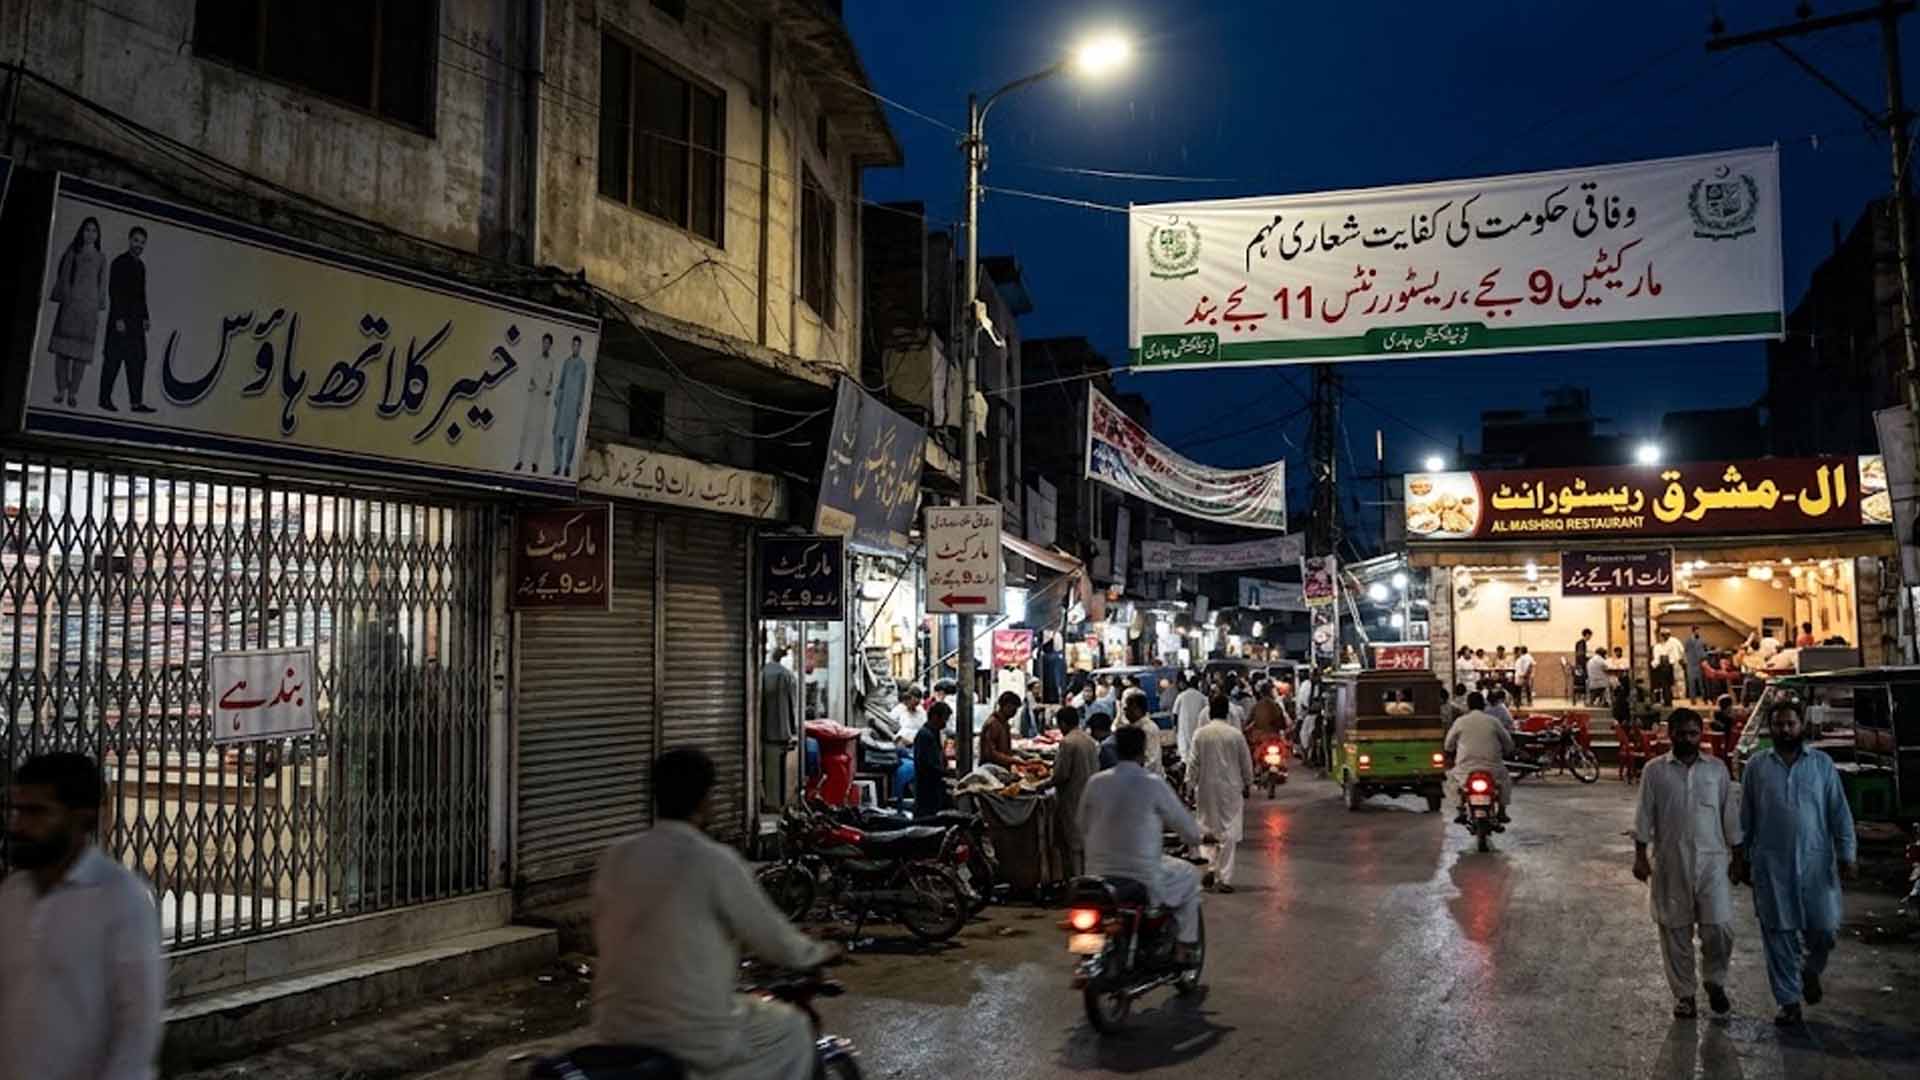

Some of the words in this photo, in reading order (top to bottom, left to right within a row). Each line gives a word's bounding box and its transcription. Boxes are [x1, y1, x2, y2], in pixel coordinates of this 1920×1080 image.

[1361, 200, 1453, 250] کفایت
[1446, 192, 1482, 248] کی
[1475, 185, 1569, 239] حکومت
[1573, 181, 1637, 238] وفاقی
[1245, 214, 1283, 272] مہم
[1278, 214, 1361, 261] شعاری
[1528, 269, 1555, 305] 9
[1558, 238, 1663, 309] مارکیٹیں
[1184, 295, 1218, 326] بند
[1222, 284, 1269, 331] بجے
[1273, 286, 1313, 321] 11
[162, 306, 306, 433] ہاؤس
[308, 312, 453, 416] کلاتھ
[411, 322, 518, 443] خیبر
[655, 465, 665, 493] 9
[1490, 477, 1645, 515] ریسٹورانٹ
[526, 511, 597, 560] مارکیٹ
[1566, 515, 1645, 531] RESTAURANT
[770, 541, 832, 579] مارکیٹ
[936, 531, 989, 562] مارکیٹ
[560, 573, 573, 593] 9
[573, 575, 604, 594] رات
[962, 570, 973, 584] 9
[1612, 567, 1634, 587] 11
[1636, 567, 1670, 586] رات
[800, 589, 812, 606] 9
[218, 680, 268, 732] ہے
[267, 667, 305, 709] بند
